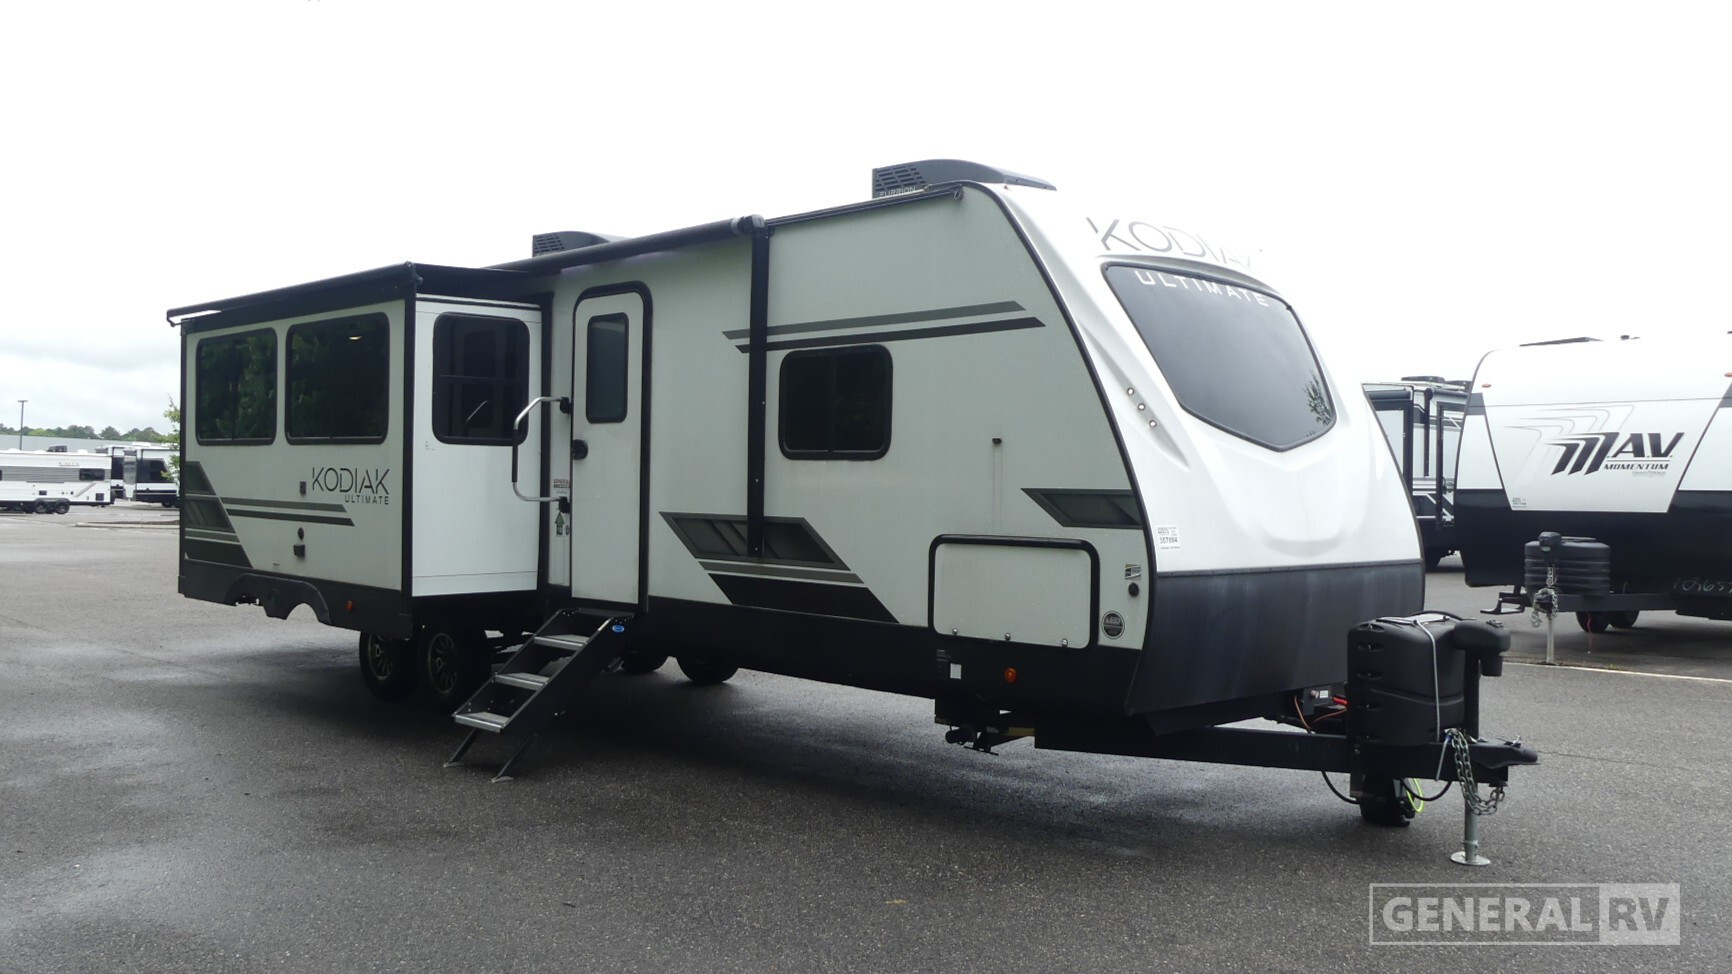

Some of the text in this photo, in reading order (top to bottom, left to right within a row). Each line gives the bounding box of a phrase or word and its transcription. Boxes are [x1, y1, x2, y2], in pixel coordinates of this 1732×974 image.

[1134, 270, 1269, 308] ULTIMATE
[312, 466, 390, 495] KODIAK
[344, 494, 390, 506] ULTIMATE
